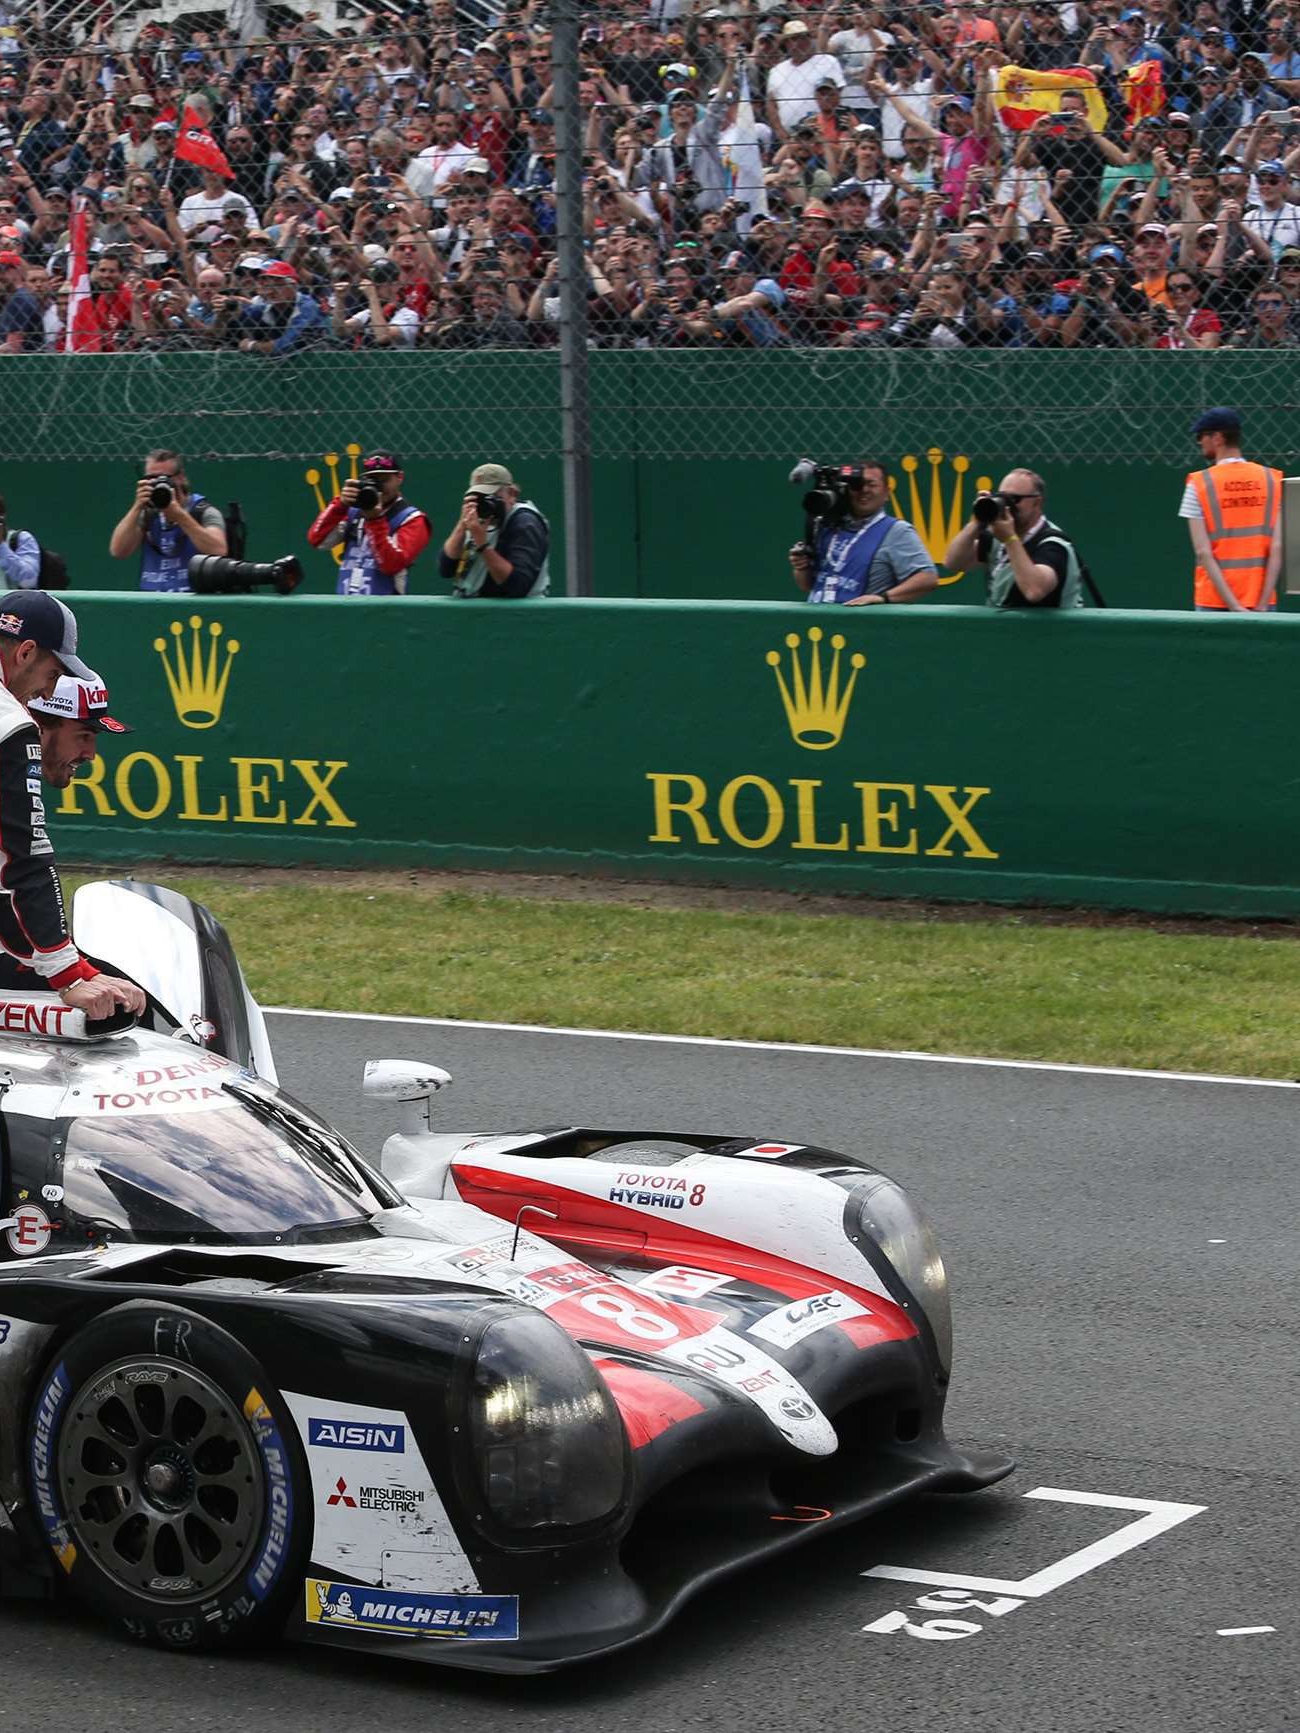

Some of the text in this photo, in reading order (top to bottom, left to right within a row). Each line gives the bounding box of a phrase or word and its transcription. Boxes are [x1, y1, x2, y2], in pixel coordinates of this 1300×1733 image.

[43, 701, 73, 712] HYBRID
[55, 751, 357, 827] ROLEX
[646, 773, 999, 859] ROLEX
[136, 1054, 230, 1086] DENSO
[94, 1087, 224, 1110] TOYOTA
[616, 1172, 687, 1192] TOYOTA
[609, 1183, 706, 1209] HYBRID 8
[18, 1216, 39, 1245] E
[653, 1269, 720, 1291] P1
[581, 1293, 680, 1340] 8
[786, 1296, 842, 1324] WEC
[154, 1316, 194, 1361] FR
[736, 1370, 781, 1393] ZENT
[37, 1376, 64, 1517] MICHELIN
[359, 1486, 425, 1502] MITSUBISHI
[360, 1500, 416, 1513] ELECTRIC
[255, 1448, 288, 1589] MICHELIN
[361, 1602, 499, 1626] MICHELIN
